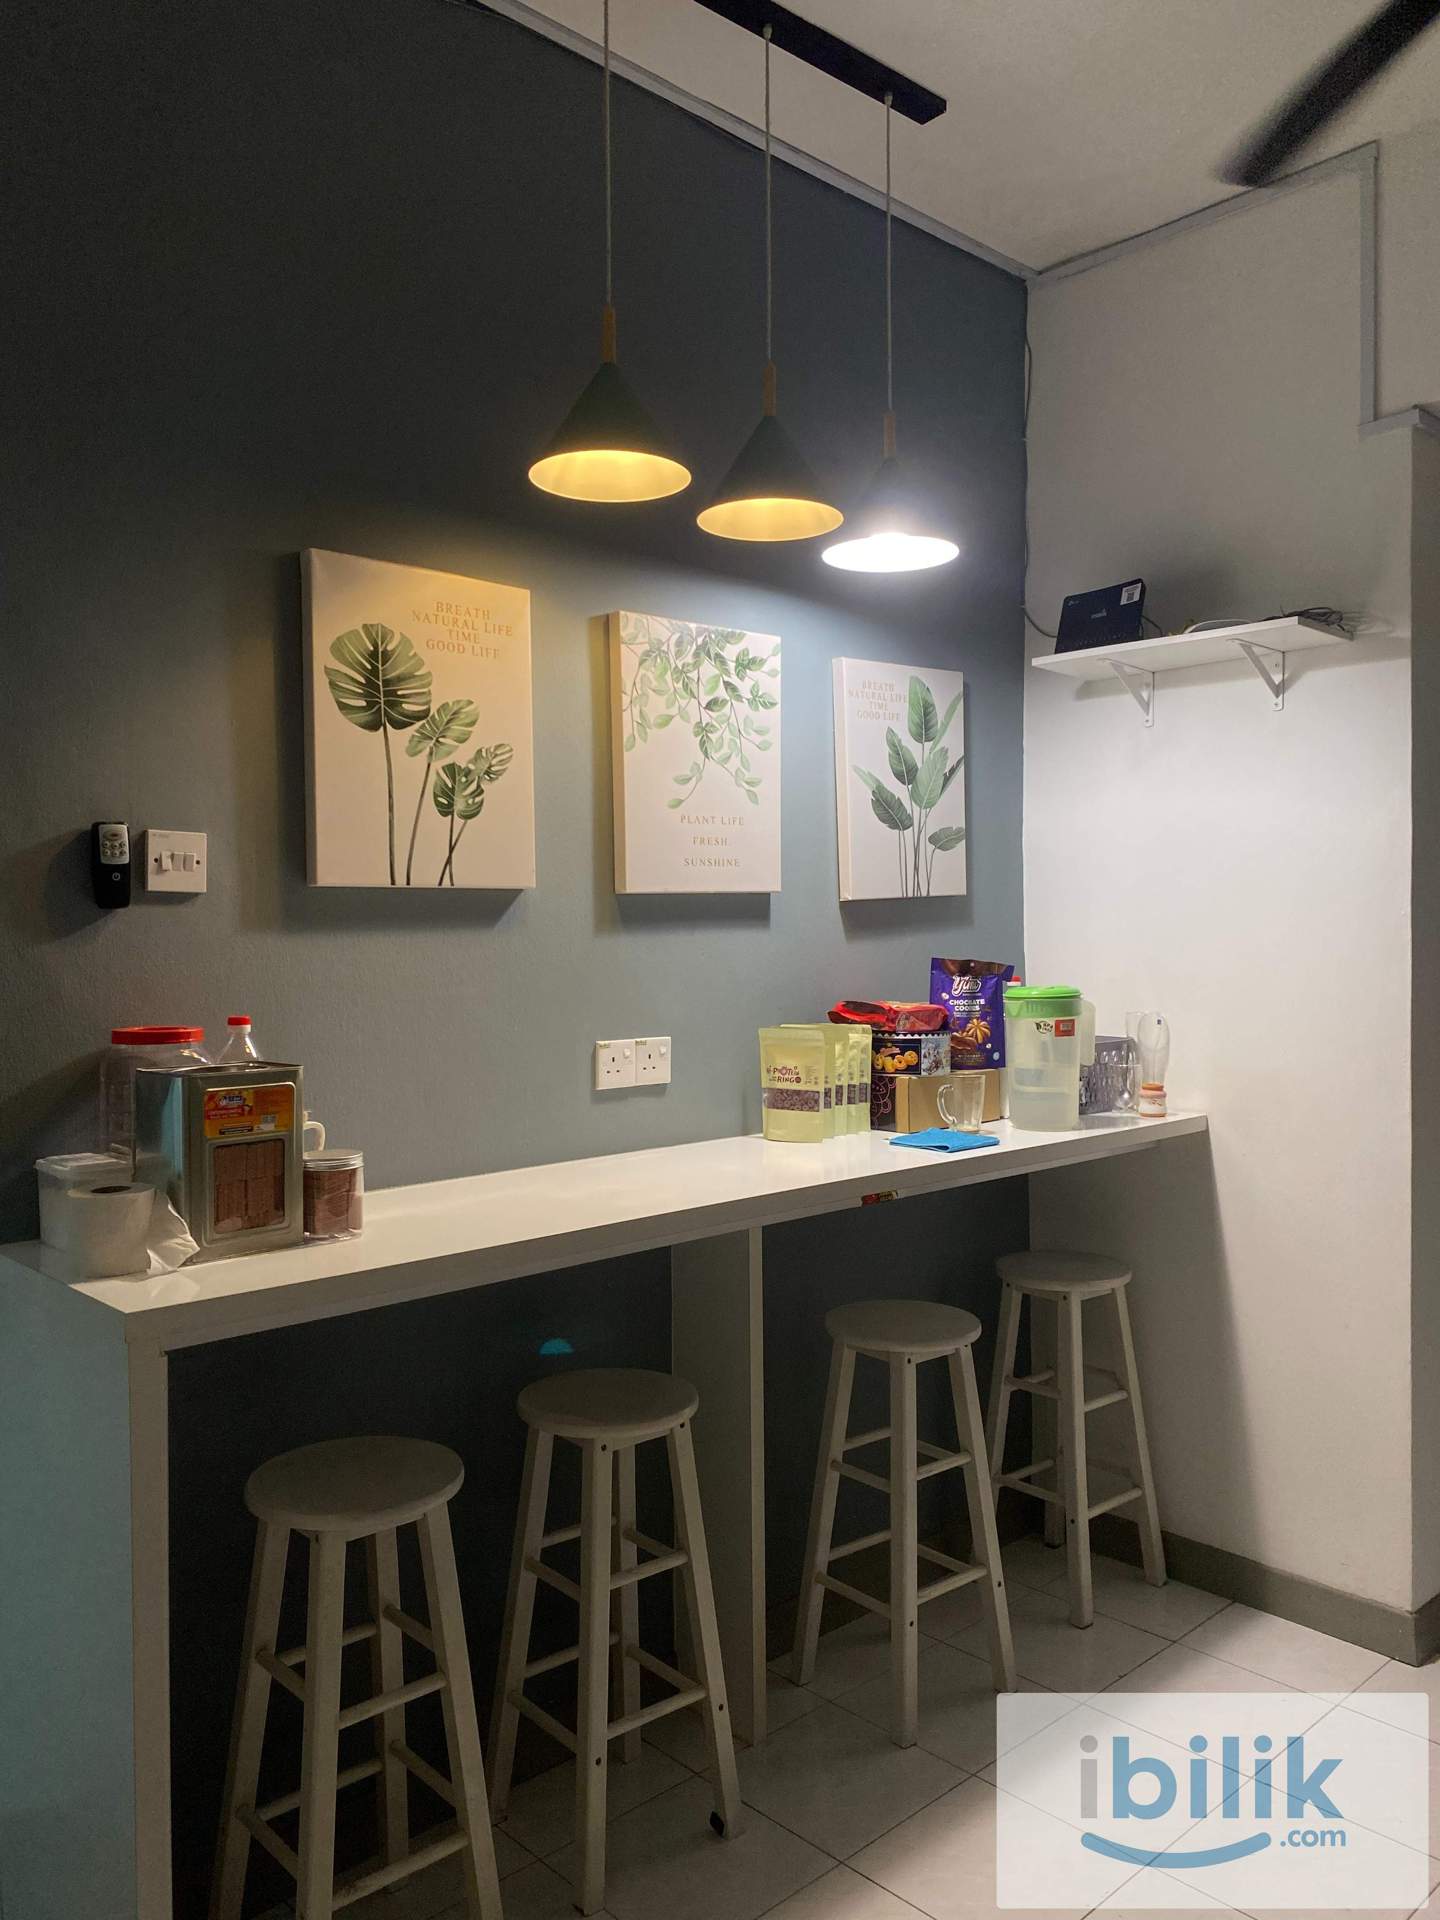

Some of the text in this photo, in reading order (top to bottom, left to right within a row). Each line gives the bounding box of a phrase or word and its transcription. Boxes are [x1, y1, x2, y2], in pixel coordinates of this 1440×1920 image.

[435, 601, 490, 621] BREATH
[411, 609, 513, 637] NATURAL LIFE
[448, 628, 481, 645] TIME
[425, 638, 500, 659] GOOD LIFE
[680, 815, 745, 826] PLANT LIFE
[692, 836, 728, 847] FRESH
[683, 857, 741, 868] SUNSHINE
